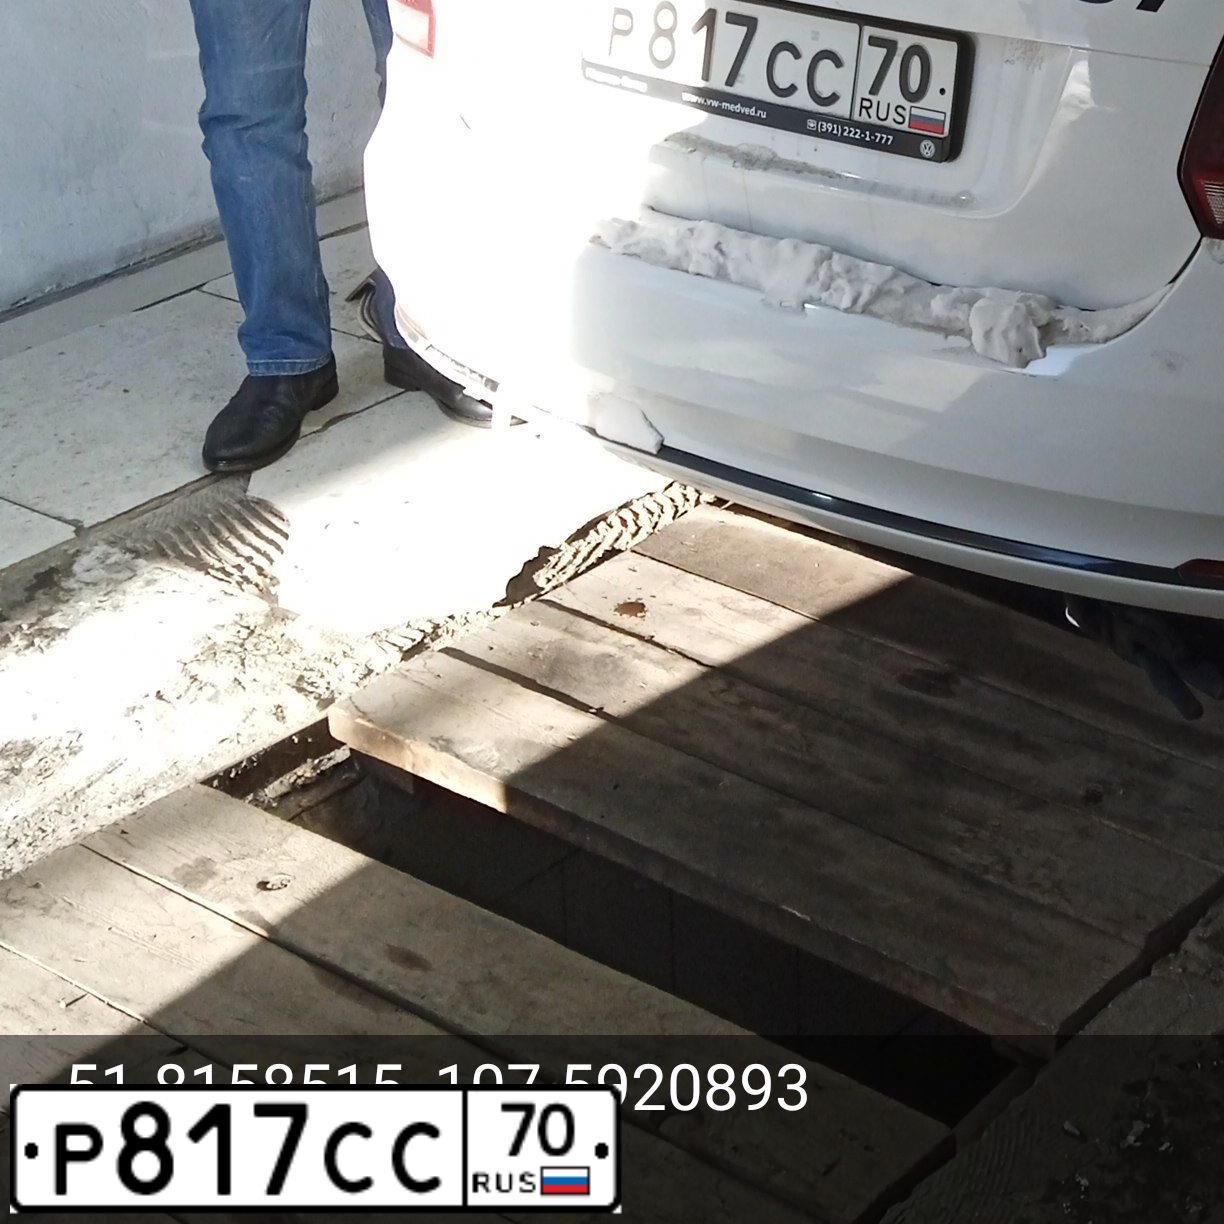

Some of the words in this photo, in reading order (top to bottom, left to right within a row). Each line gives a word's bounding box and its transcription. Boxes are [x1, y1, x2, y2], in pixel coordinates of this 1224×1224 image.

[867, 34, 932, 104] 70
[858, 97, 908, 125] RUS
[842, 124, 894, 146] 222-1-777
